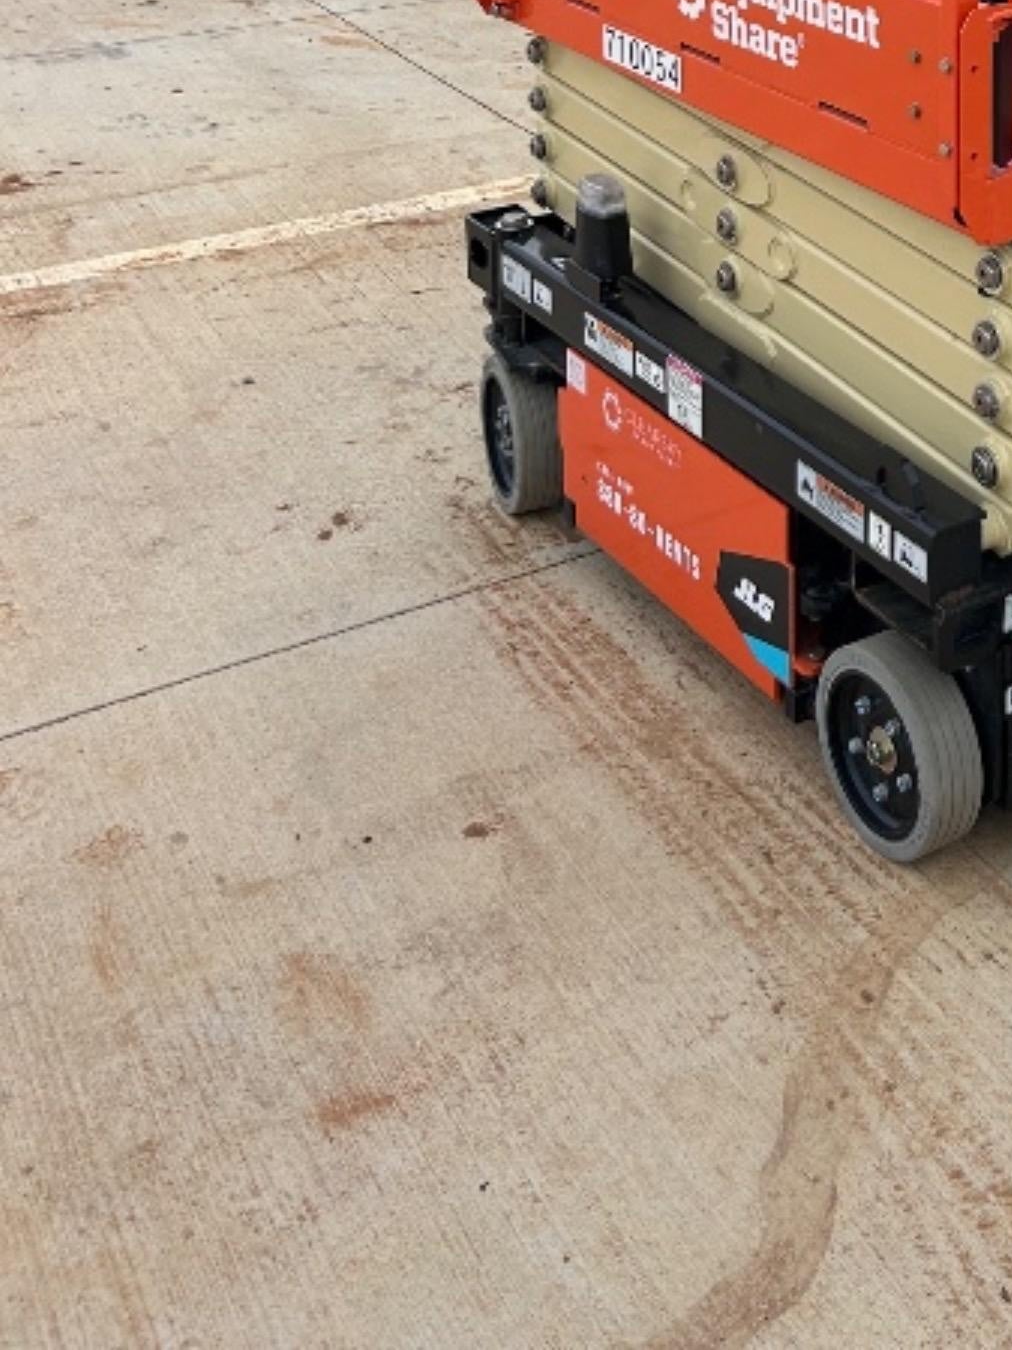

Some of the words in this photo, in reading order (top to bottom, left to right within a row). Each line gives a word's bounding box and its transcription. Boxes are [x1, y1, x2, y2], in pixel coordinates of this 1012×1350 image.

[606, 28, 679, 87] 710054
[710, 5, 799, 68] Share
[733, 576, 777, 624] JLG
